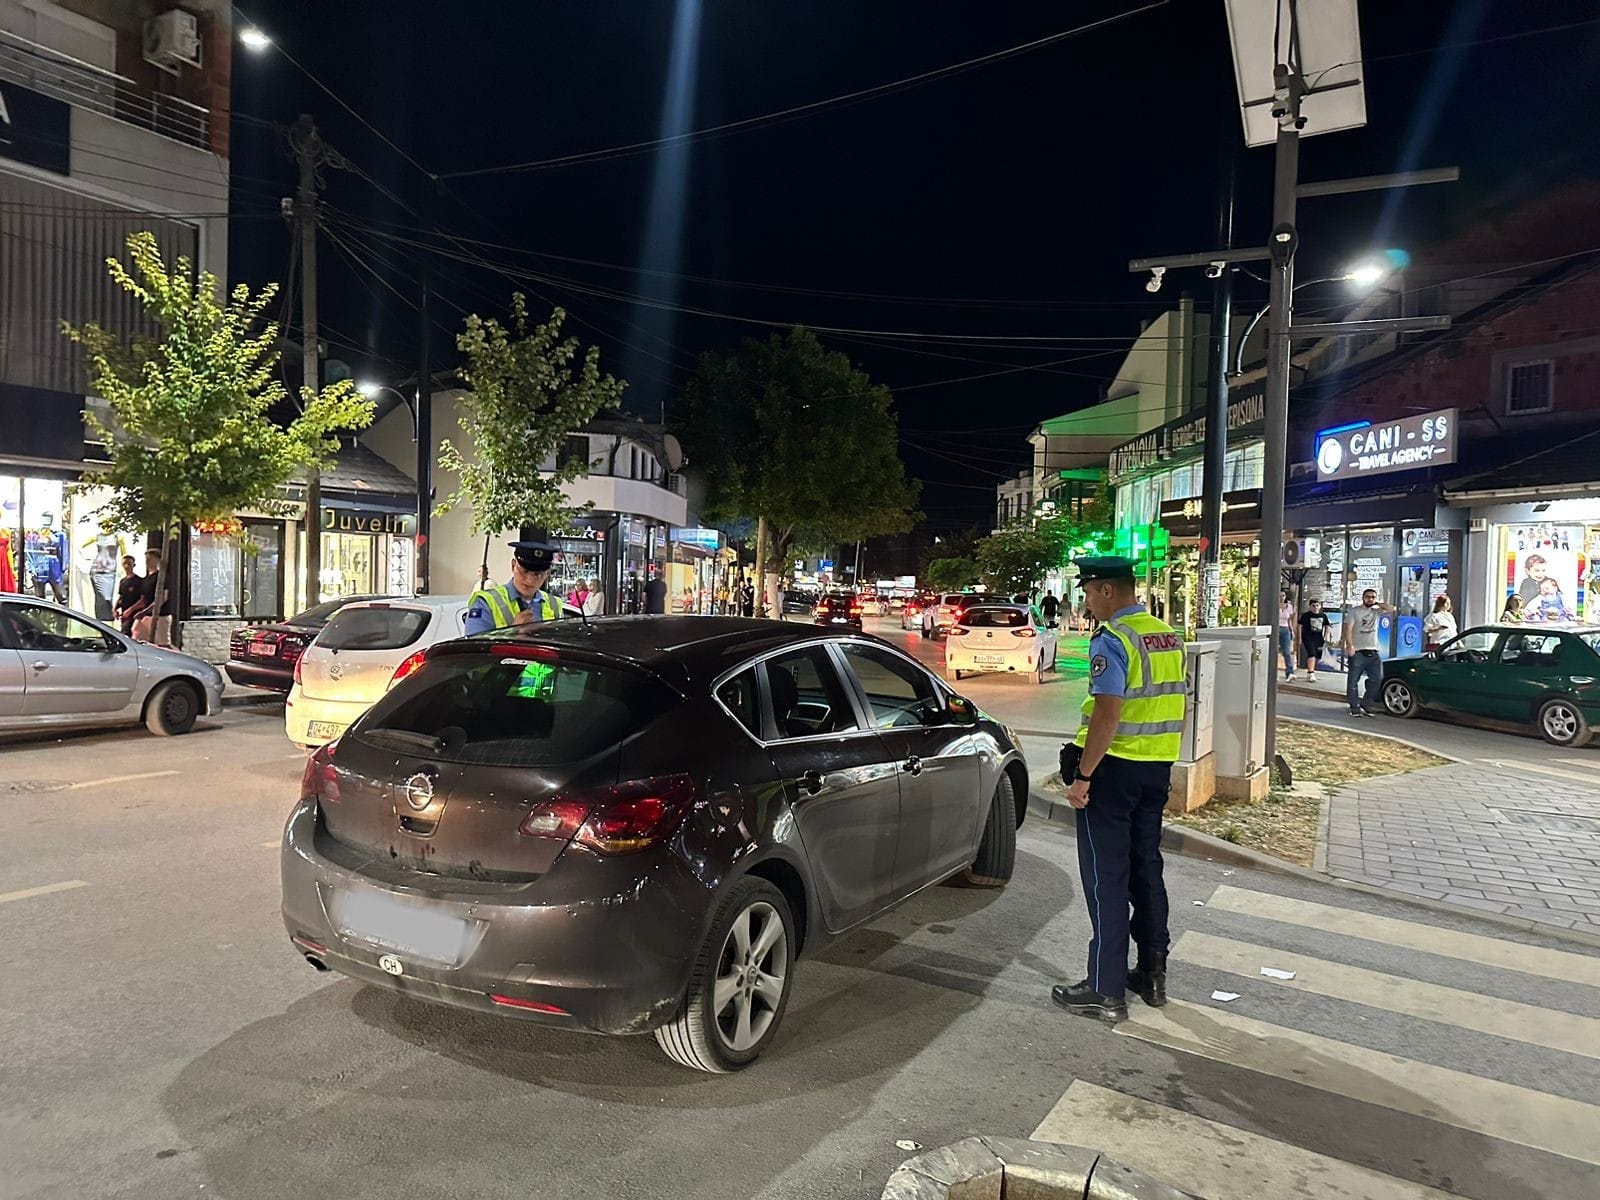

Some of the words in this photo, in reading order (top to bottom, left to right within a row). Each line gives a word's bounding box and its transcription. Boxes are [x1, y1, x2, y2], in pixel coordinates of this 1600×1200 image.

[1228, 394, 1264, 429] EPISONA
[1350, 425, 1401, 455] CANI
[1422, 415, 1448, 442] SS
[1358, 451, 1391, 470] TRAVEL
[1391, 445, 1435, 466] AGENCY
[326, 509, 409, 534] Juvelir
[383, 958, 397, 972] CH
